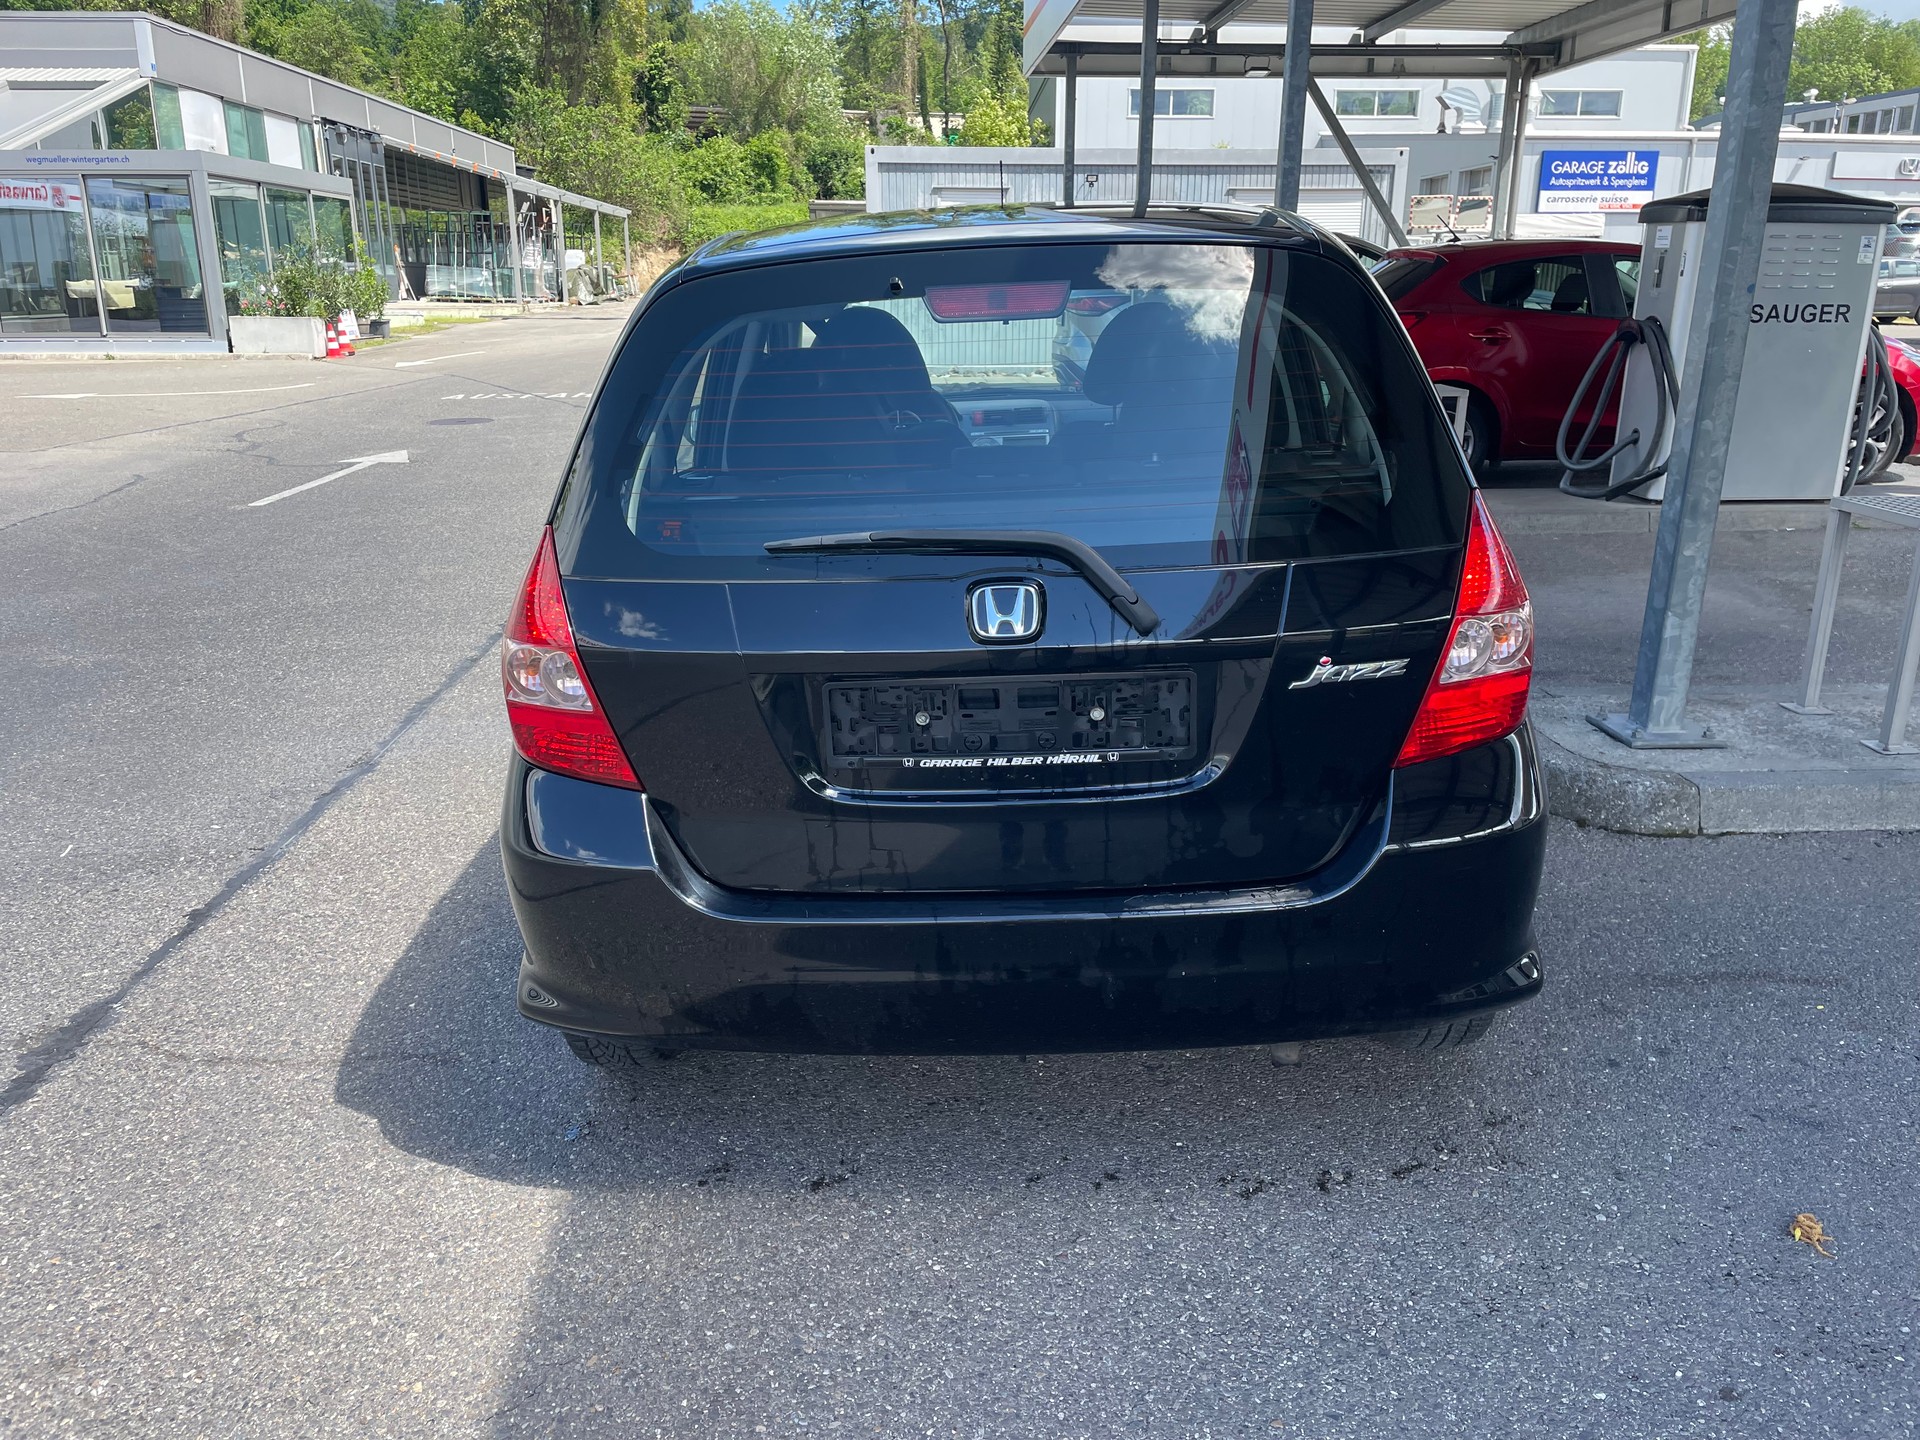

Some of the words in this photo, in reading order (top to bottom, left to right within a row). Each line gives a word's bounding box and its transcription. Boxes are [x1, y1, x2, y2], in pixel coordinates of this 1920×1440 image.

[25, 155, 130, 165] wegmueller-wintergarten.ch
[1551, 161, 1605, 174] GARAGE
[1549, 176, 1601, 188] Autospritzwerk
[1602, 176, 1609, 186] &
[1610, 176, 1648, 188] Spenglerei
[1546, 194, 1598, 204] carrosserie
[1600, 193, 1629, 203] suisse
[1750, 303, 1851, 324] SAUGER
[919, 758, 983, 768] GARAGE
[986, 757, 1044, 767] HILBER
[1046, 753, 1103, 766] MÄRWIL
